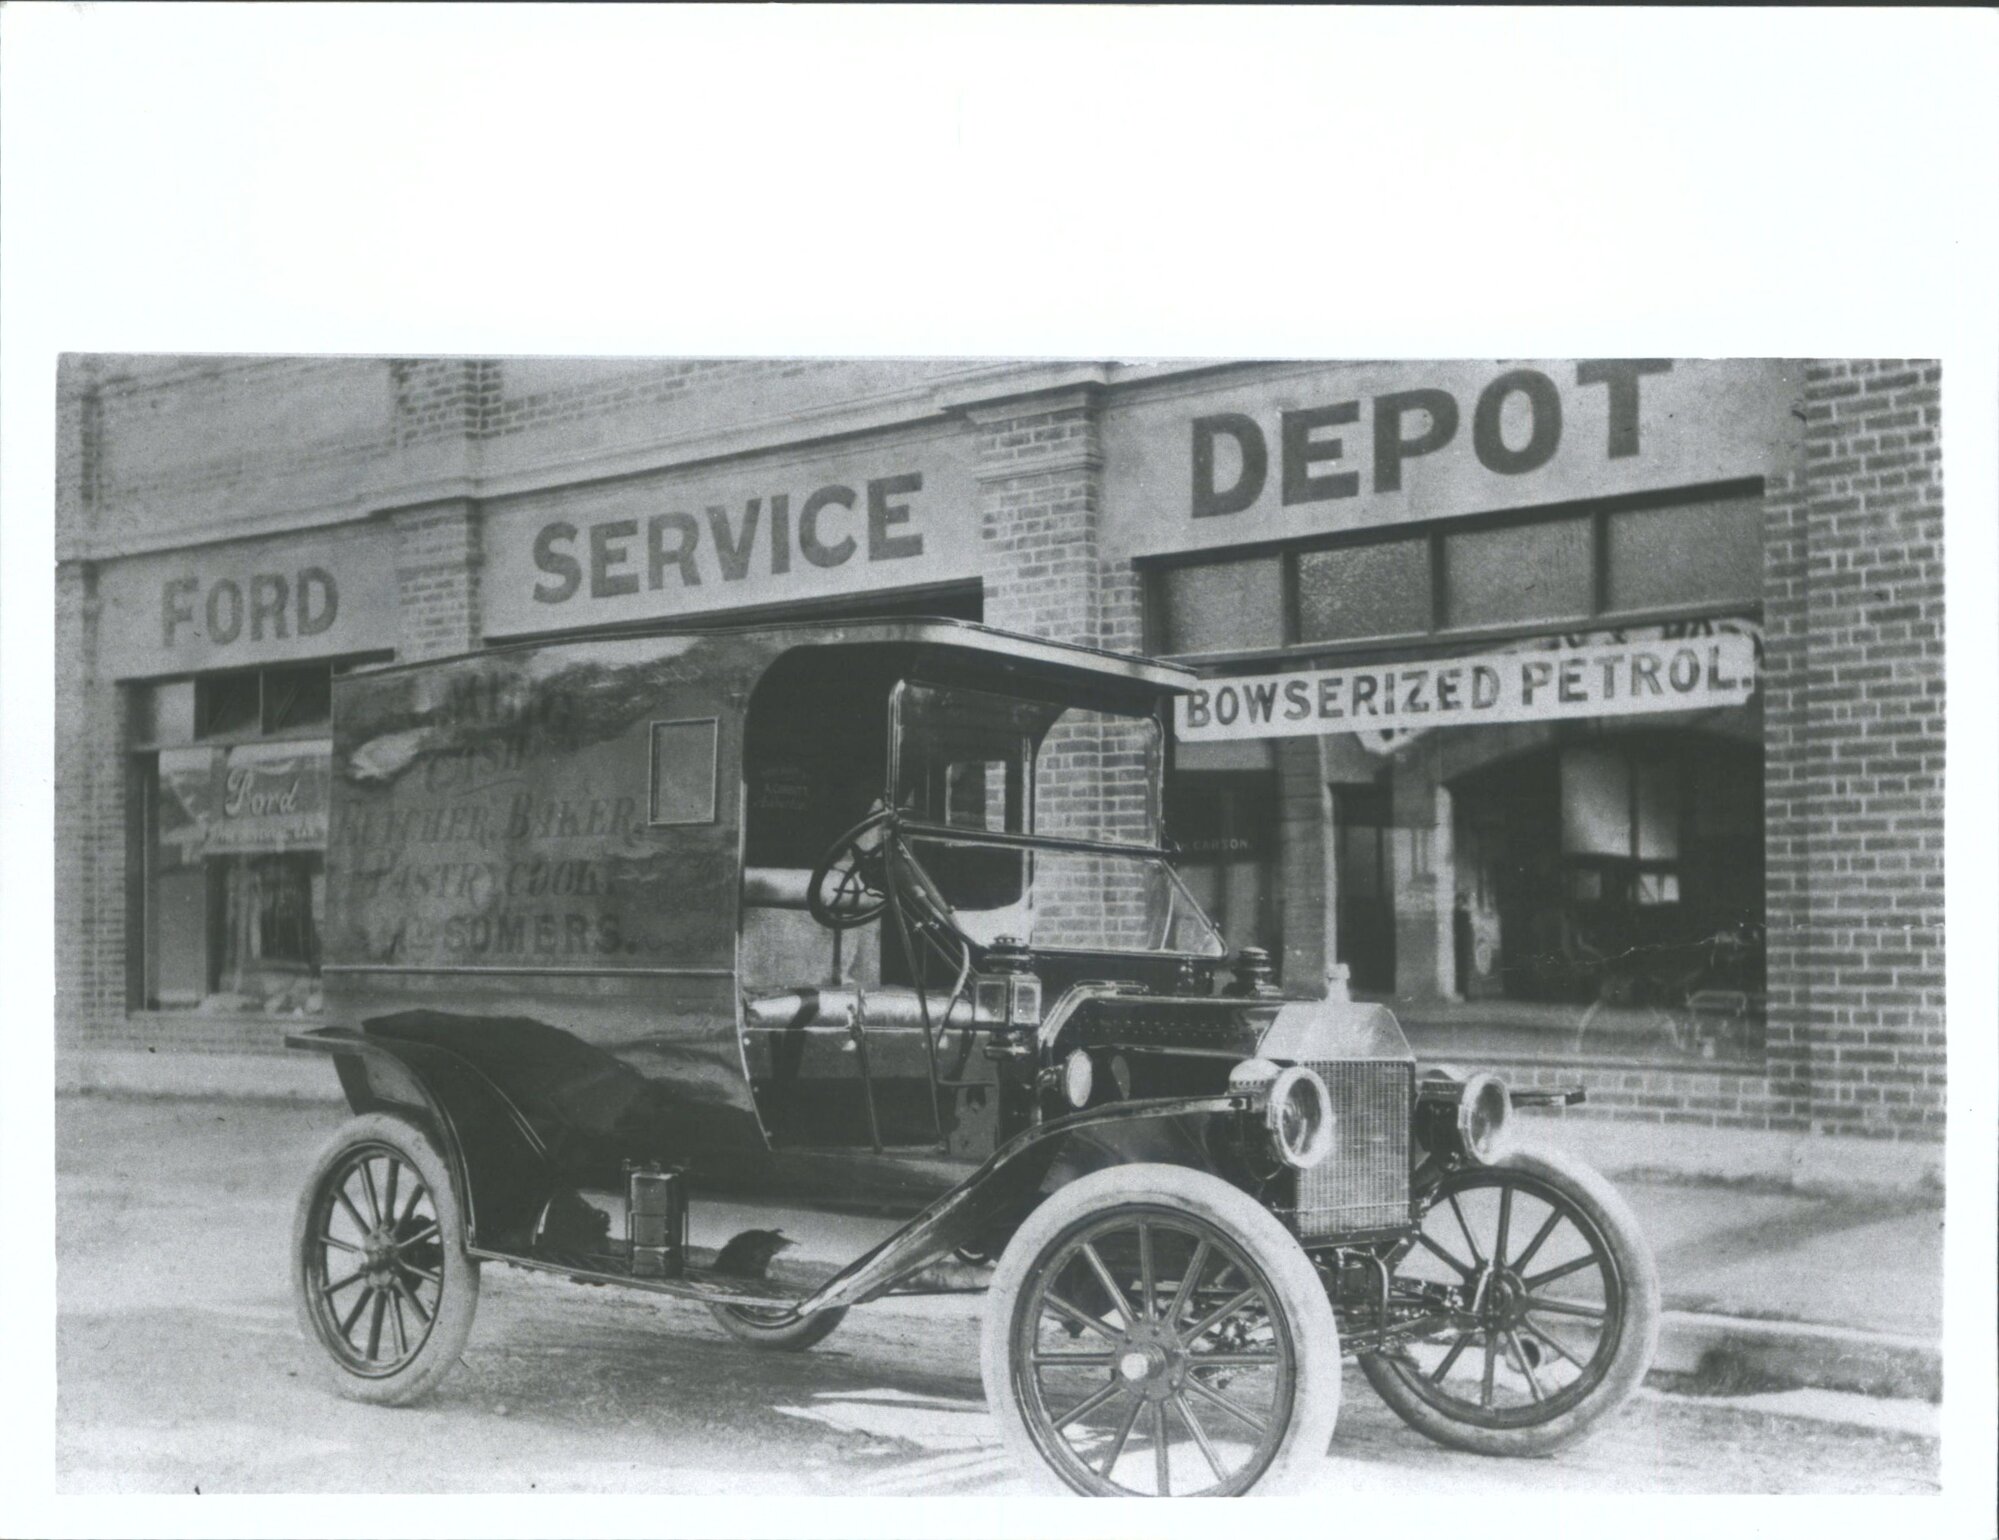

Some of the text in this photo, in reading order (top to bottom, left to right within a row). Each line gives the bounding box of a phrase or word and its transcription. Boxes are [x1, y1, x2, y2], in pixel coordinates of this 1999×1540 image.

[162, 358, 1673, 647] FORD SERVICE DEPOT
[1187, 645, 1752, 728] BOWSERIZED PETROL.
[225, 768, 302, 817] Ford
